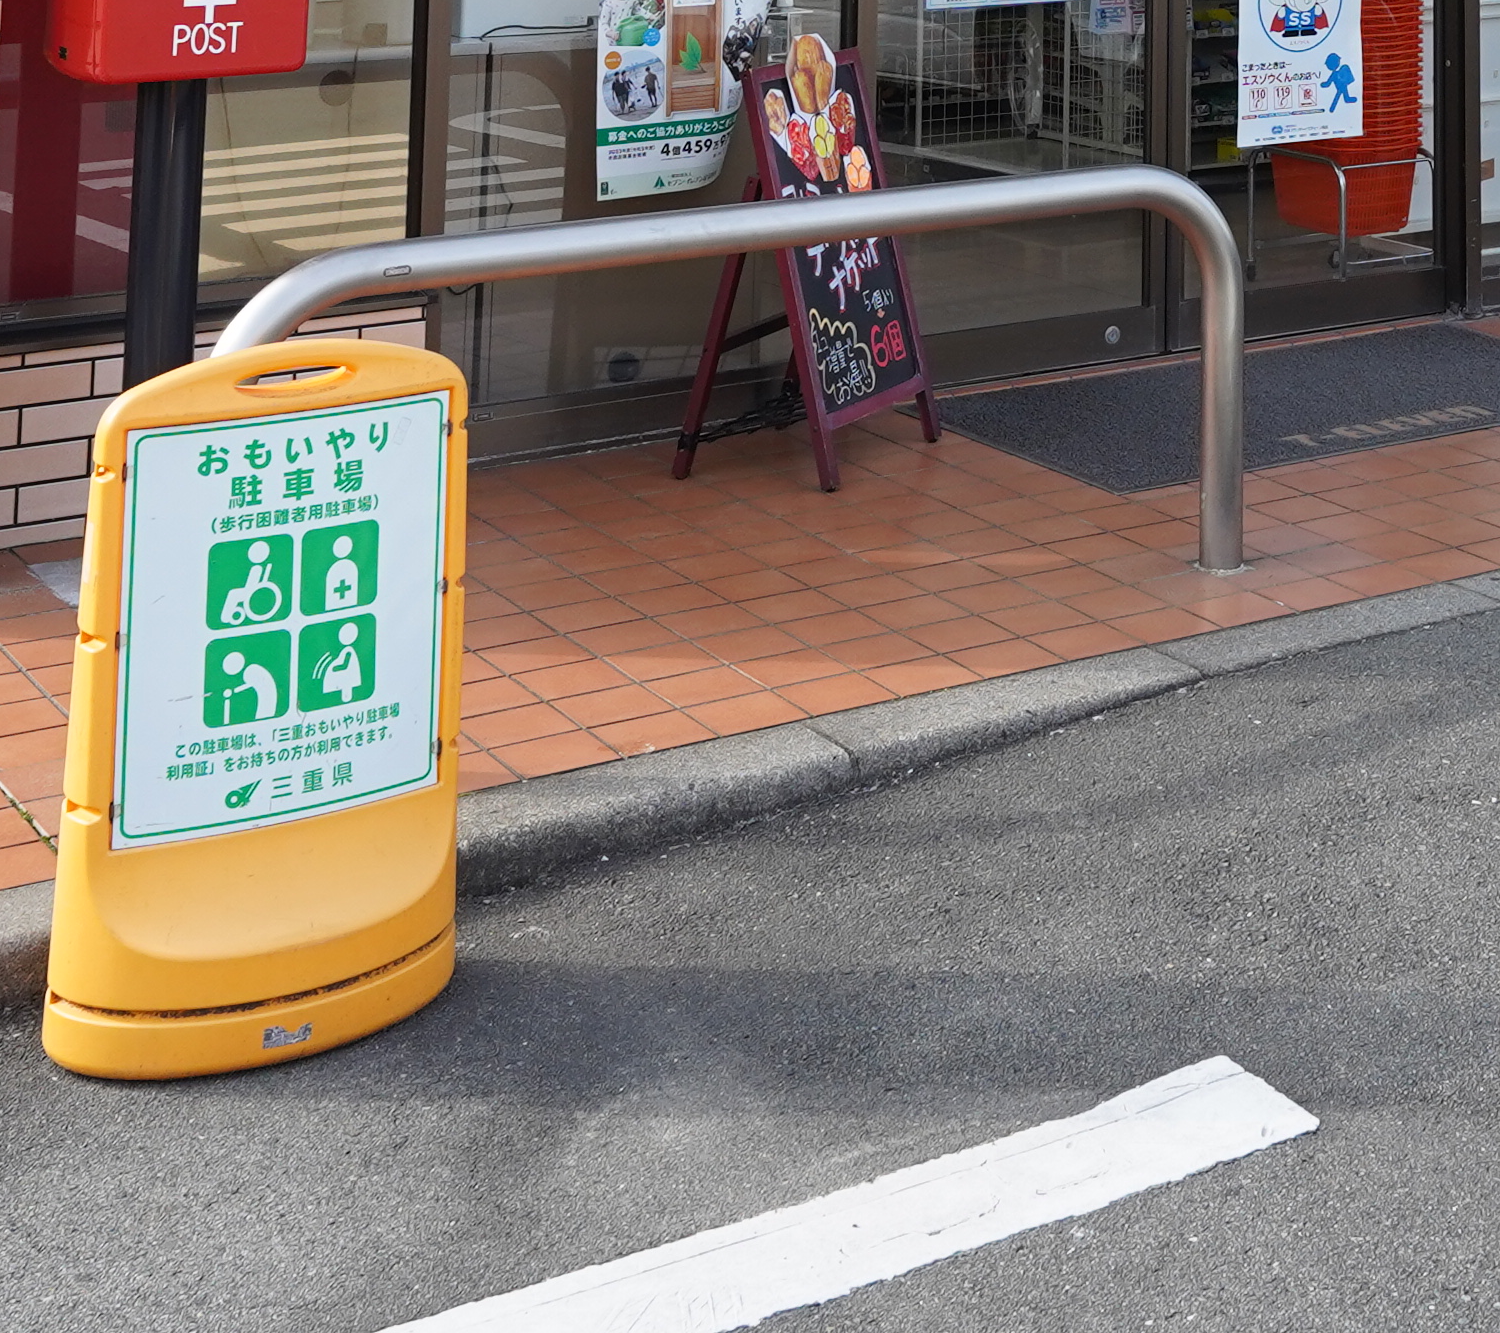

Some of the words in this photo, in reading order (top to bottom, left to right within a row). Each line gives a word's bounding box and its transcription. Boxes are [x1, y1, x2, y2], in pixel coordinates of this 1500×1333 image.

[172, 21, 244, 56] POST
[1288, 12, 1312, 27] SS
[1251, 89, 1266, 99] 110
[1275, 87, 1290, 97] 119
[863, 288, 894, 312] 5個入り
[870, 320, 906, 368] 6個
[199, 419, 391, 477] おもいやり
[229, 462, 364, 511] 駐車場
[210, 493, 380, 536] (歩行困難者用駐車場)
[174, 701, 401, 758] この駐車場は、「三重おもいやり駐車場
[166, 726, 396, 781] 利用証」をお持ちの方が利用できます。
[271, 764, 354, 799] 三重県
